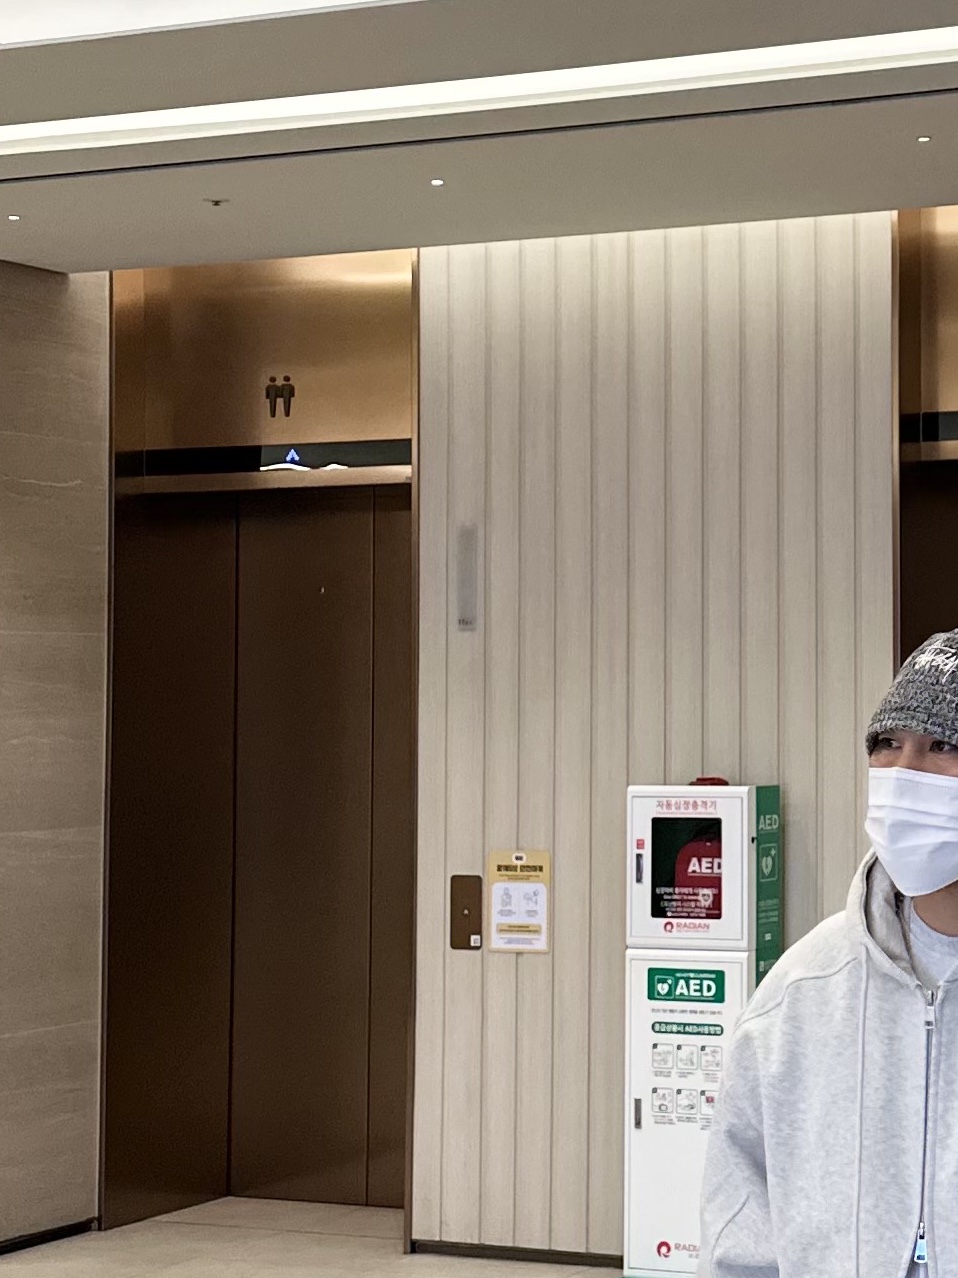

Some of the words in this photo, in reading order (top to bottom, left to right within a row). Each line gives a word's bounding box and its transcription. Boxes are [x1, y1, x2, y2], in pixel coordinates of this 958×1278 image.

[758, 814, 779, 830] AED
[675, 979, 716, 997] AED
[674, 1243, 701, 1252] RADI
